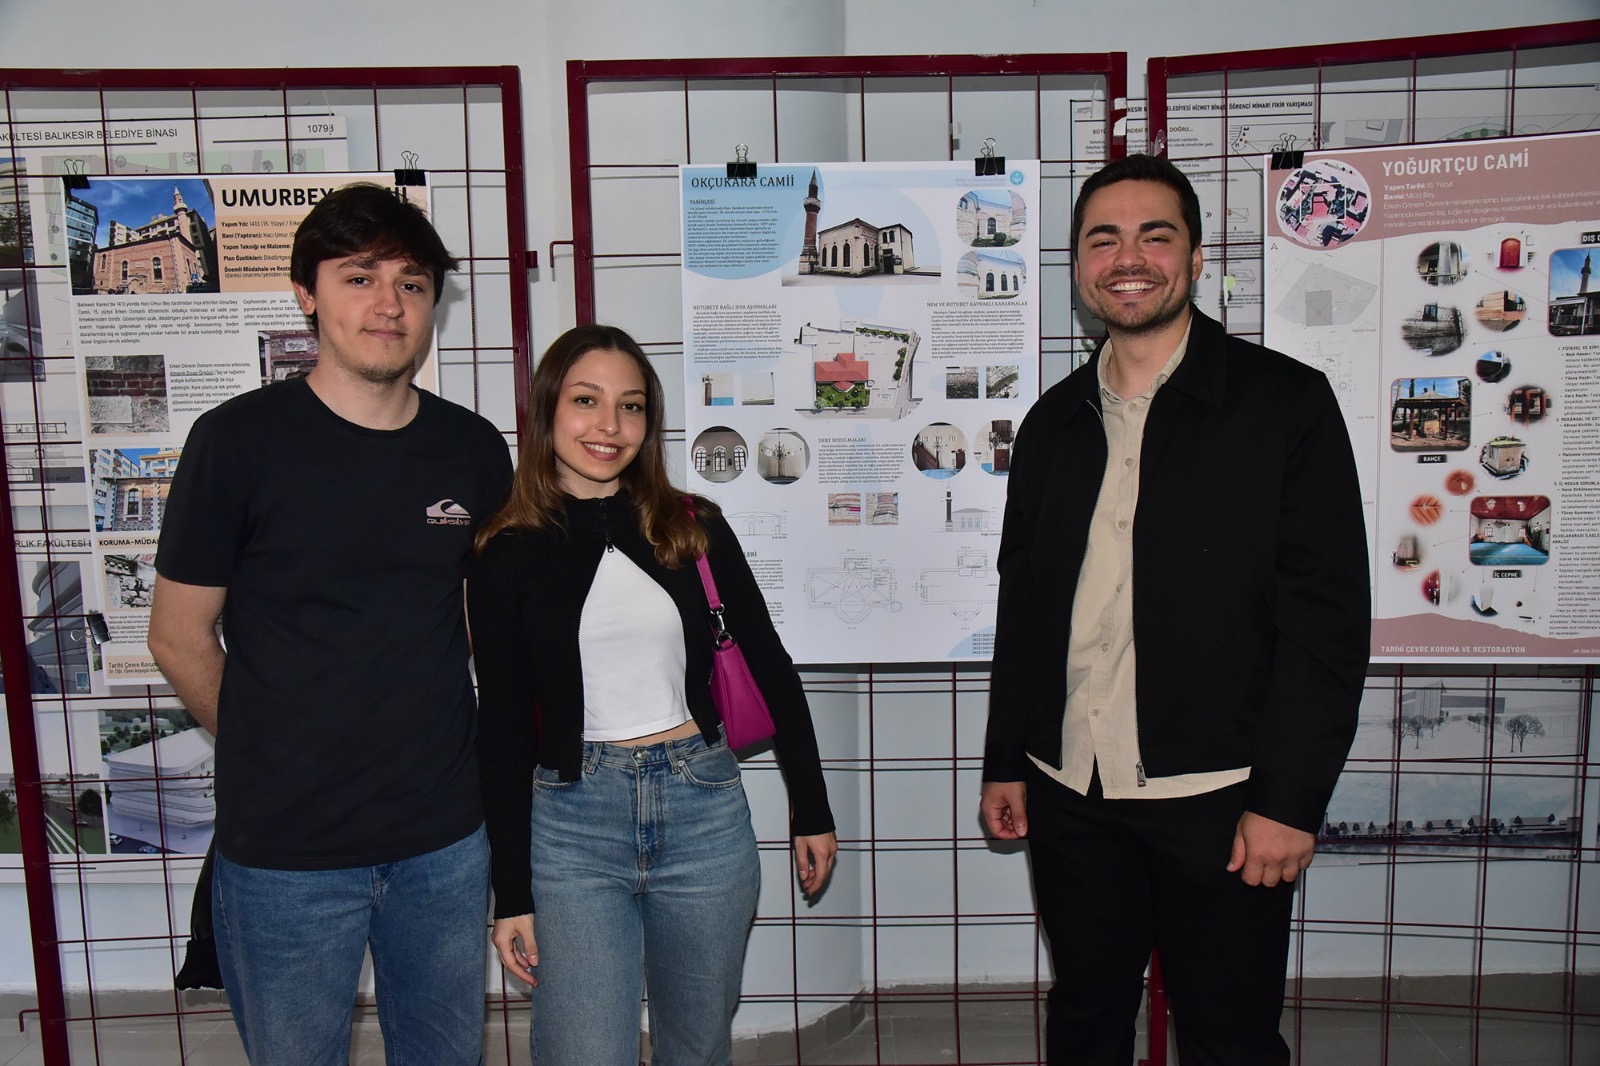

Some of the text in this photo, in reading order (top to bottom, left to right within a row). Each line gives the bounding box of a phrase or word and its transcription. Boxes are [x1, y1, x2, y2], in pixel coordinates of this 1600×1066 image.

[45, 130, 94, 140] BALIKESİR
[97, 128, 143, 139] BELEDİYE
[146, 128, 178, 138] BİNASI
[1382, 148, 1528, 176] YOĞURTÇU CAMİ
[691, 174, 794, 190] OKÇUKARA CAMİİ
[222, 188, 334, 206] UMURBEY
[1583, 234, 1596, 242] DIŞ
[37, 538, 86, 548] FAKÜLTESİ
